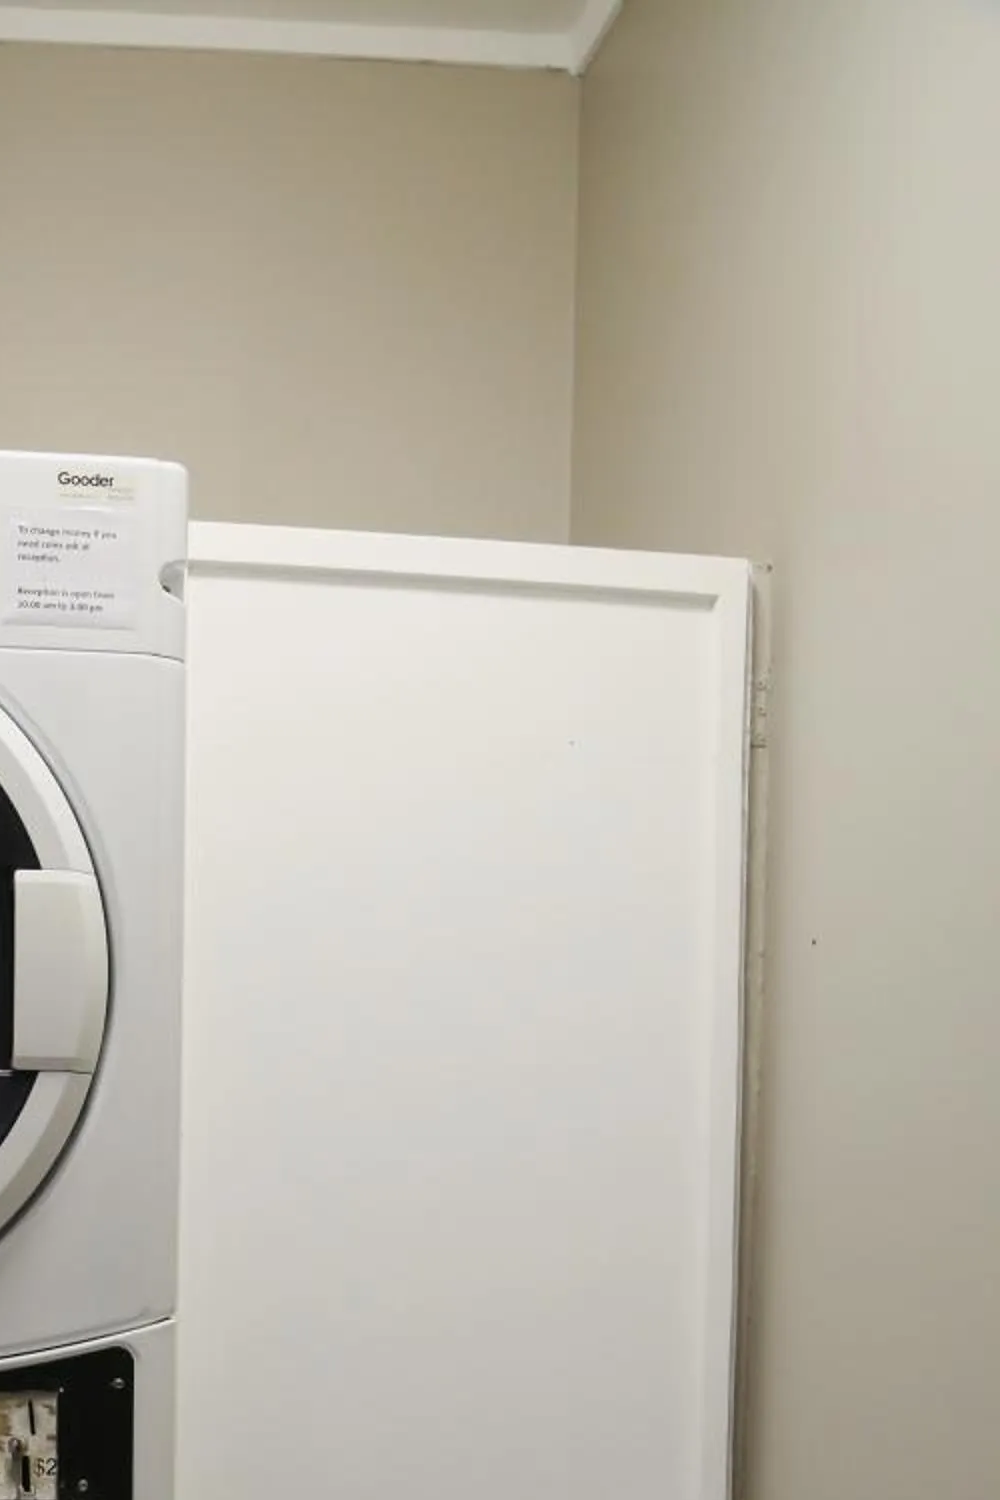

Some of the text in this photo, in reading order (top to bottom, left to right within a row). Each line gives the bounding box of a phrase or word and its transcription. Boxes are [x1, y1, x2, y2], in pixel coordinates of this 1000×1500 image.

[57, 471, 115, 488] Gooder
[30, 526, 60, 537] change
[17, 586, 59, 596] Reception
[33, 1457, 57, 1478] $2
